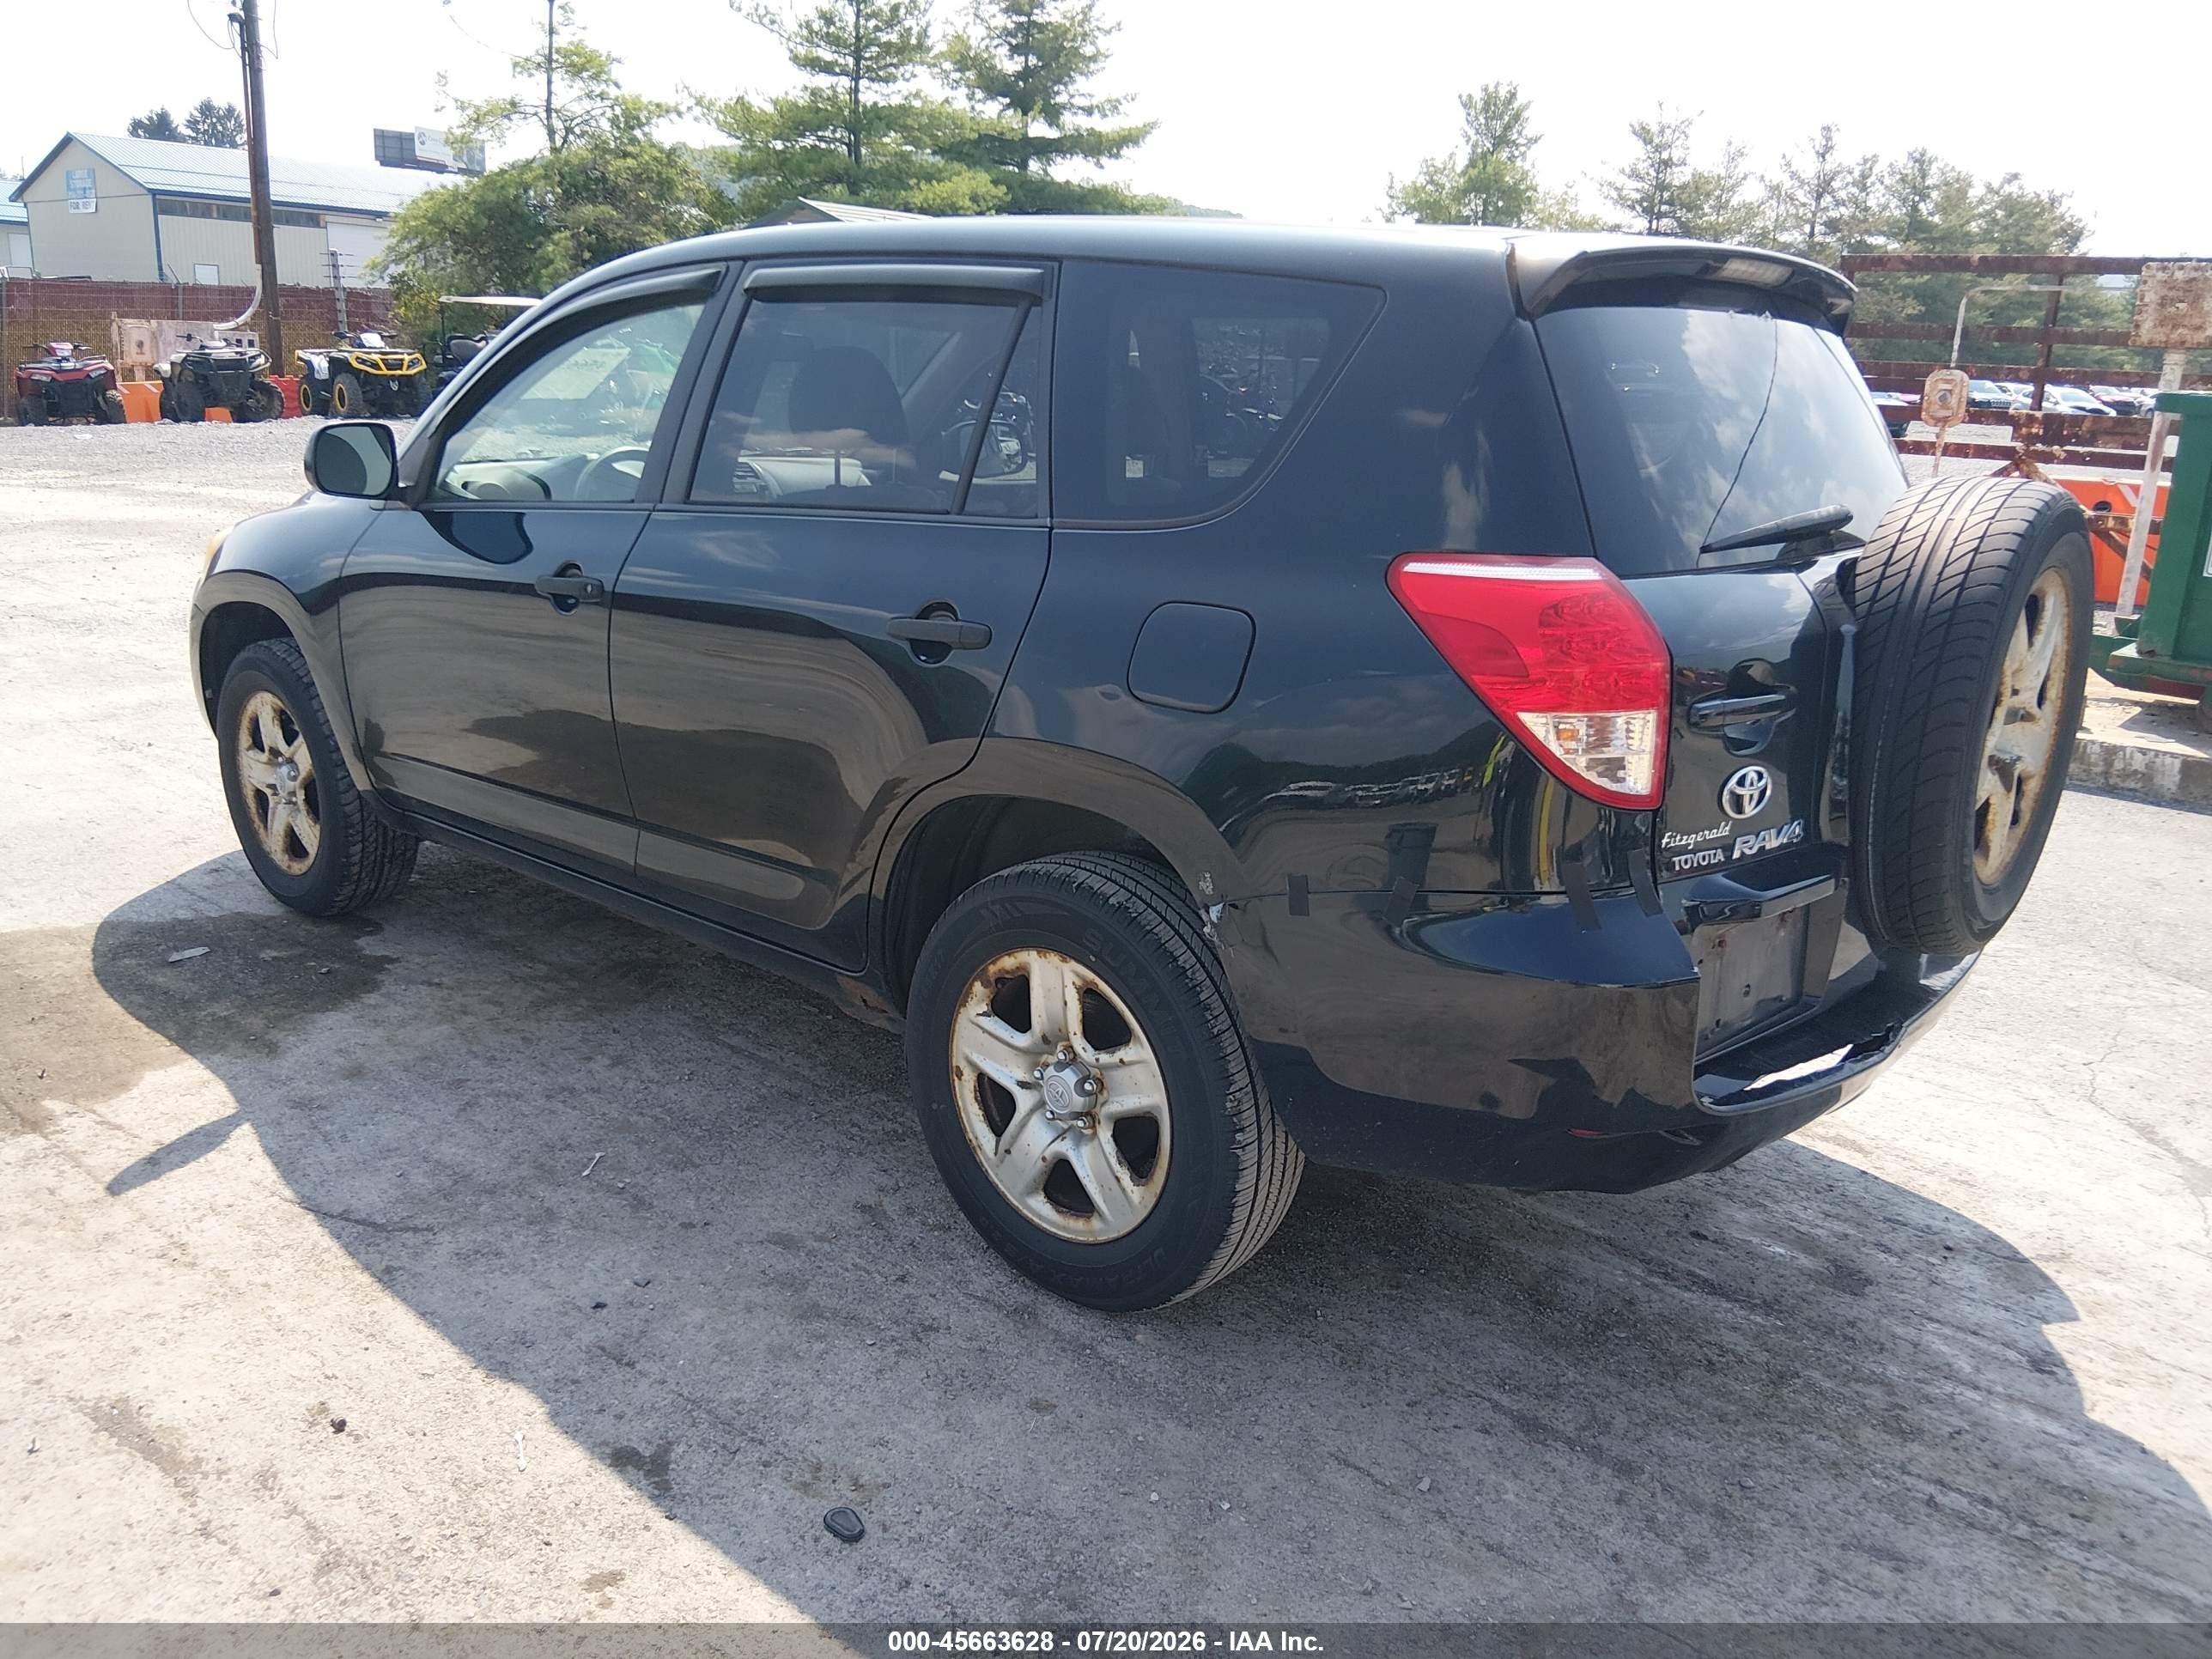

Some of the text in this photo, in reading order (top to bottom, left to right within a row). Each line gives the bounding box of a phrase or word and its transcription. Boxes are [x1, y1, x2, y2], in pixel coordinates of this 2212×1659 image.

[70, 201, 80, 210] FOR
[1662, 820, 1732, 848] Fitzgerald
[1733, 819, 1804, 860] RAV4
[1673, 849, 1725, 871] TOYOTA
